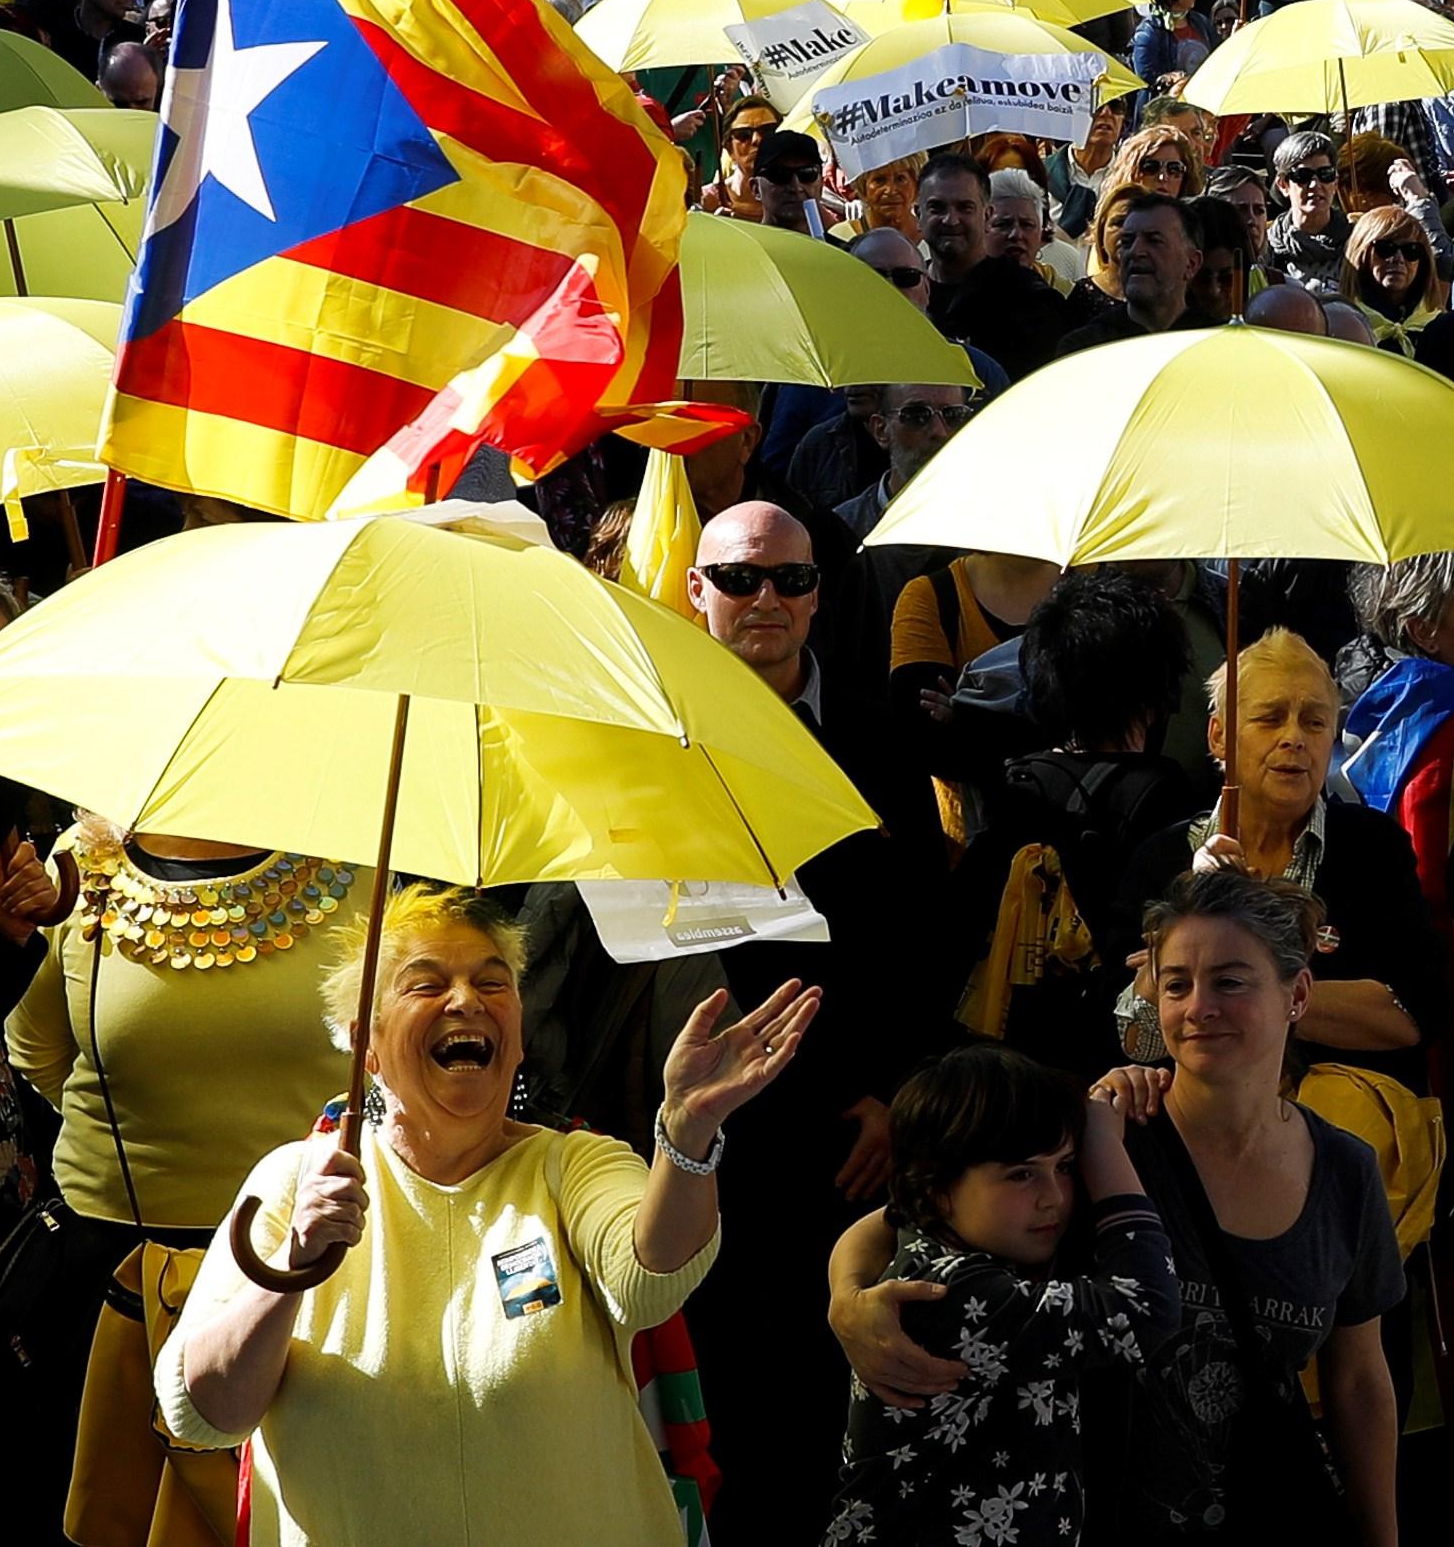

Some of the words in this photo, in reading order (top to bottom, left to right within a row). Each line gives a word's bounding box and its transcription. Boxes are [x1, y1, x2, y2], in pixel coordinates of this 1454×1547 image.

[836, 74, 1082, 135] #Makeamove
[851, 110, 933, 146] Autodeterminazioa
[935, 106, 947, 115] ez
[949, 100, 962, 111] da
[998, 98, 1045, 111] eskubidea
[1048, 104, 1074, 115] baizik
